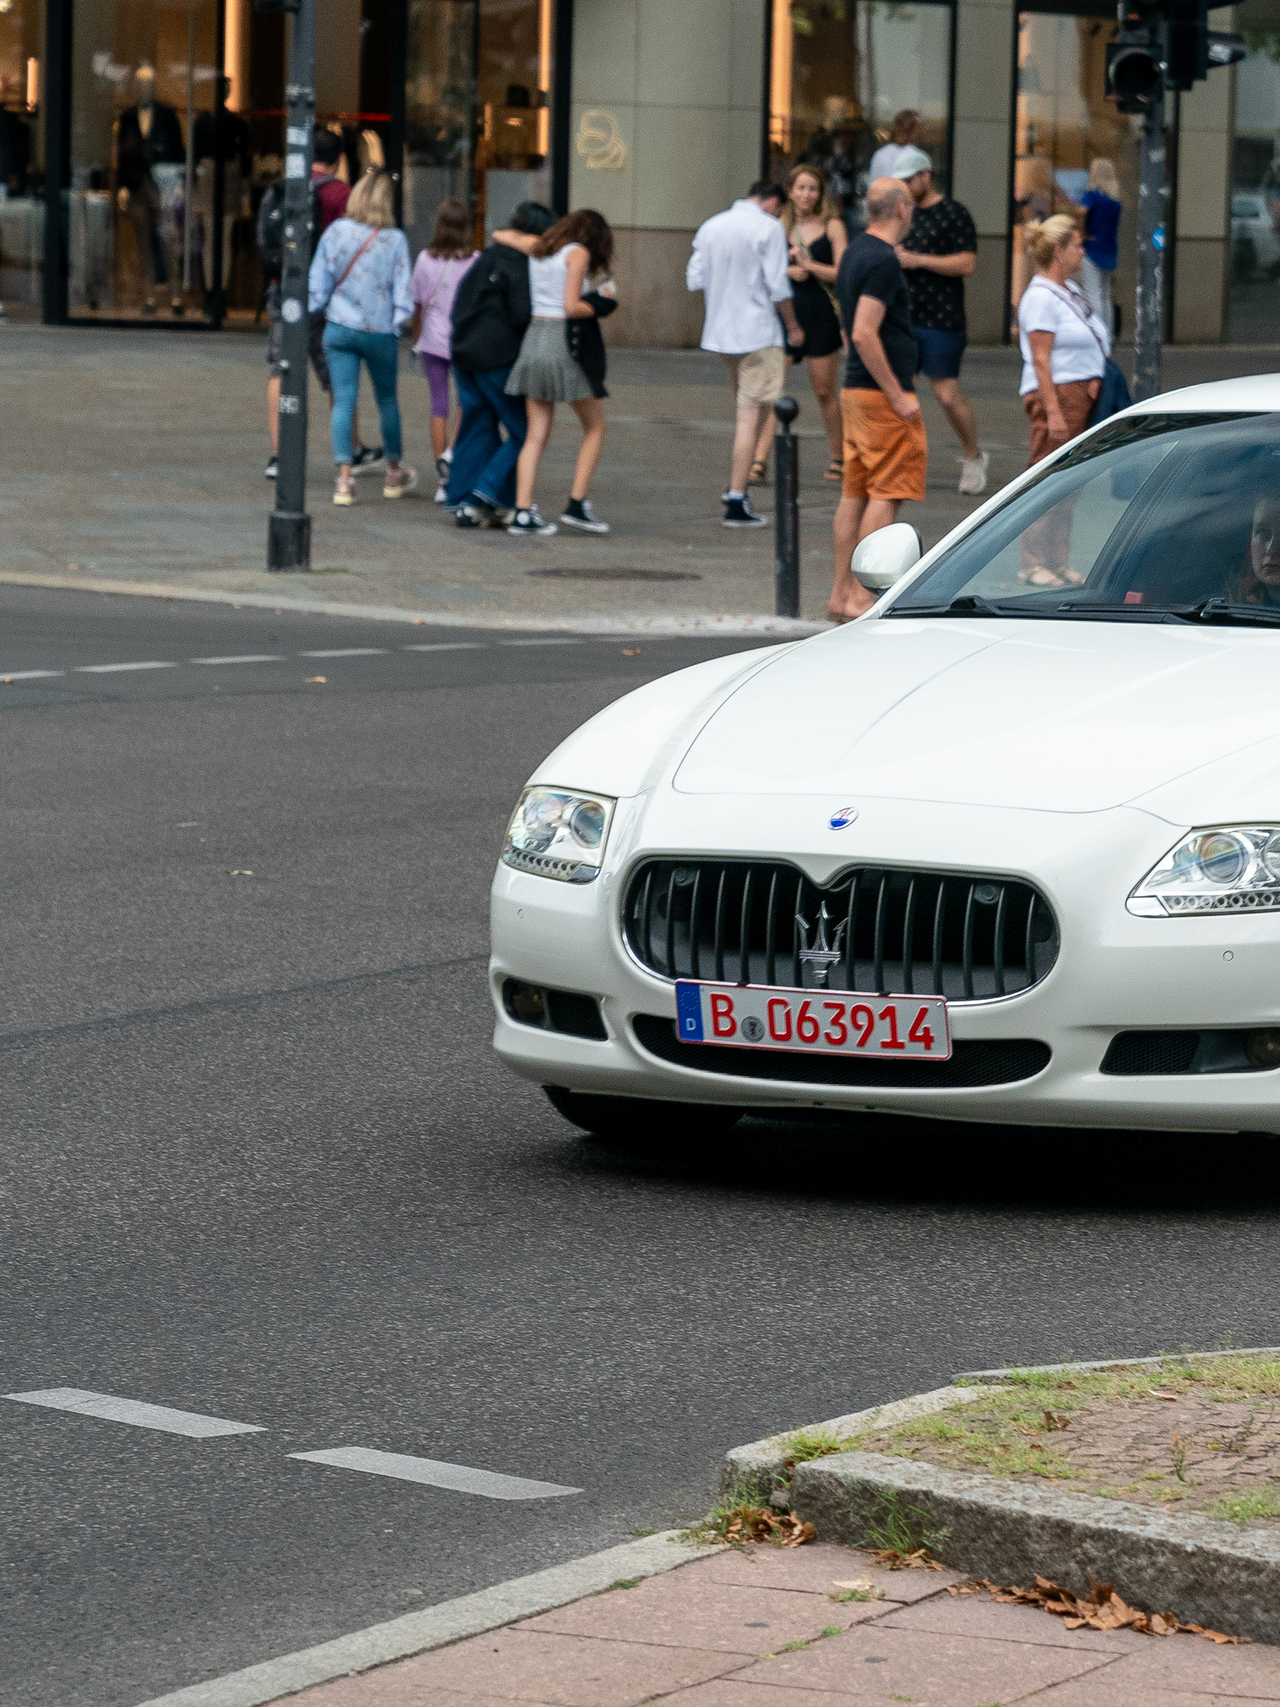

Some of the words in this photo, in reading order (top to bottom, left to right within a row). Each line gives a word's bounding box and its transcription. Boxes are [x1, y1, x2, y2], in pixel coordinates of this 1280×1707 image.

[685, 1018, 697, 1031] D
[709, 992, 738, 1037] B
[767, 997, 935, 1050] 063914
